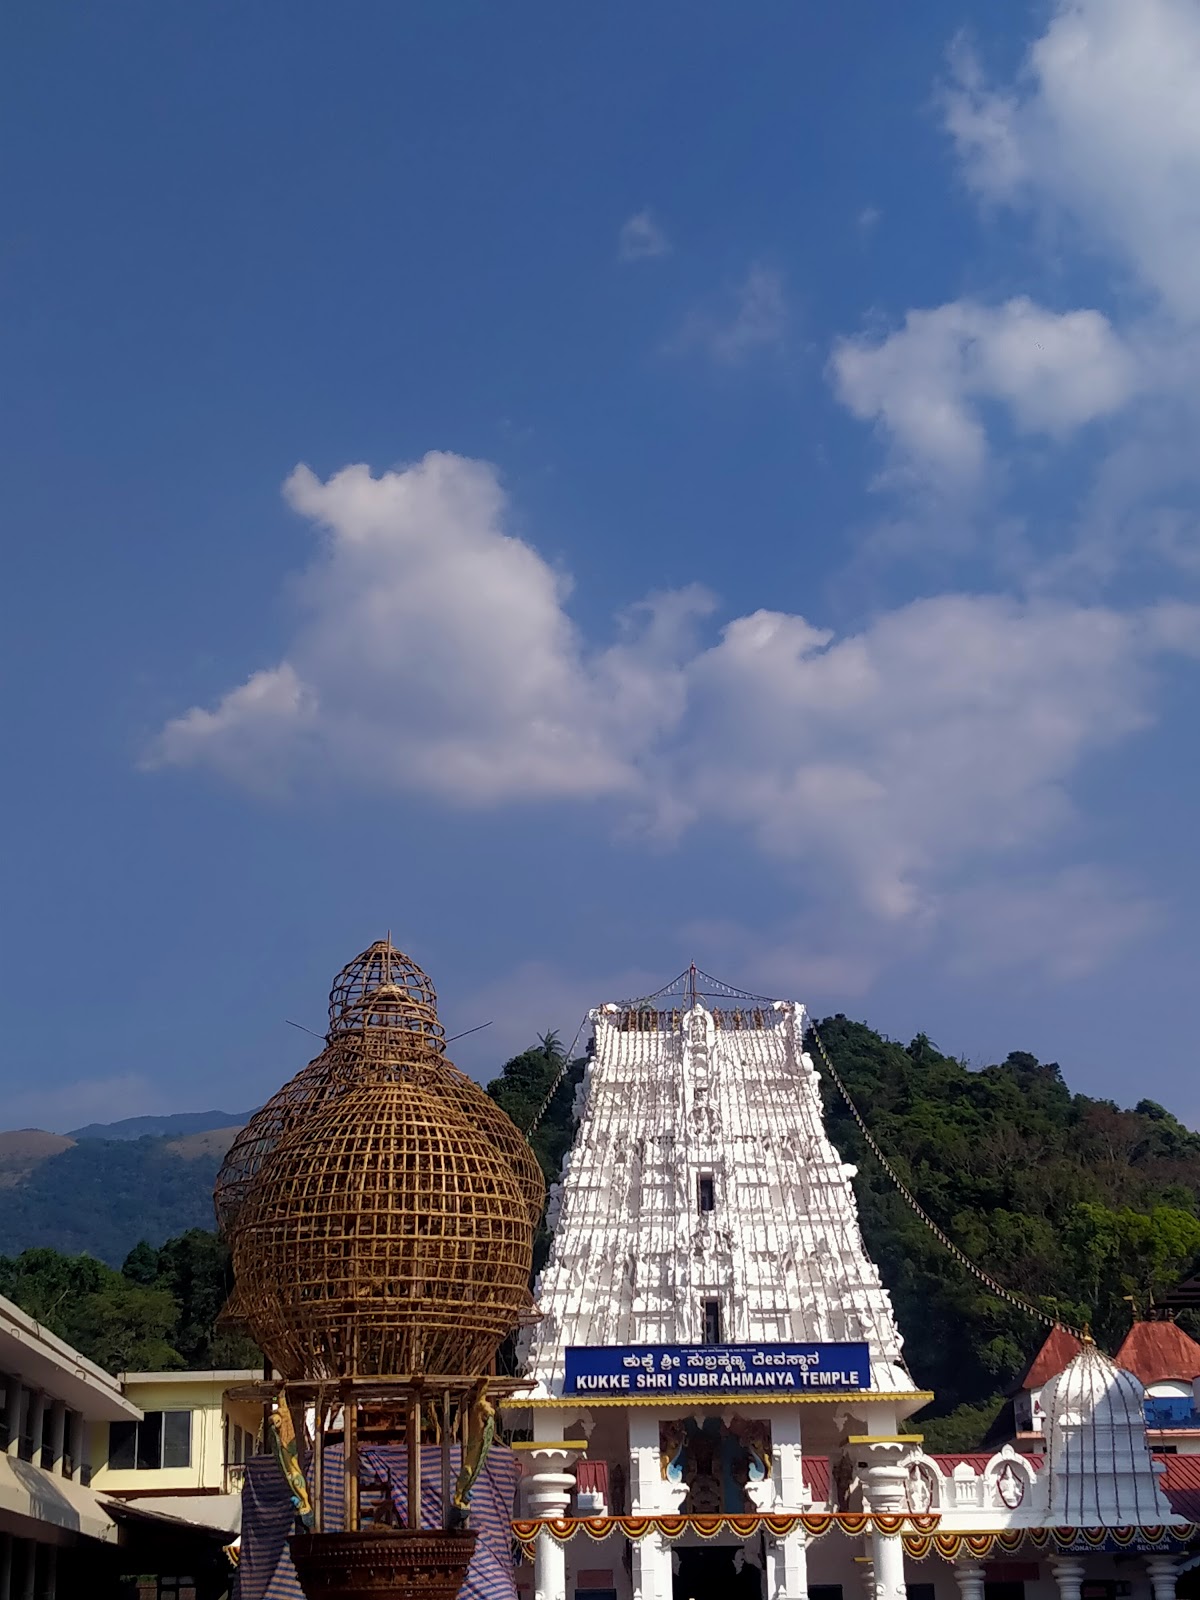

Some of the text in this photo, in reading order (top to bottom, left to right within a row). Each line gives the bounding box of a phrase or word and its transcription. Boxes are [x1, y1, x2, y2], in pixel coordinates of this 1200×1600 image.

[622, 1351, 820, 1373] ಕುಕ್ಕೆ ಶ್ರೀ ಸುಬ್ರಹ್ಮಣ್ಯ ದೇವಸ್ಥಾನ
[576, 1371, 860, 1389] KUKKE SHRI SUBRAHMANYA TEMPLE
